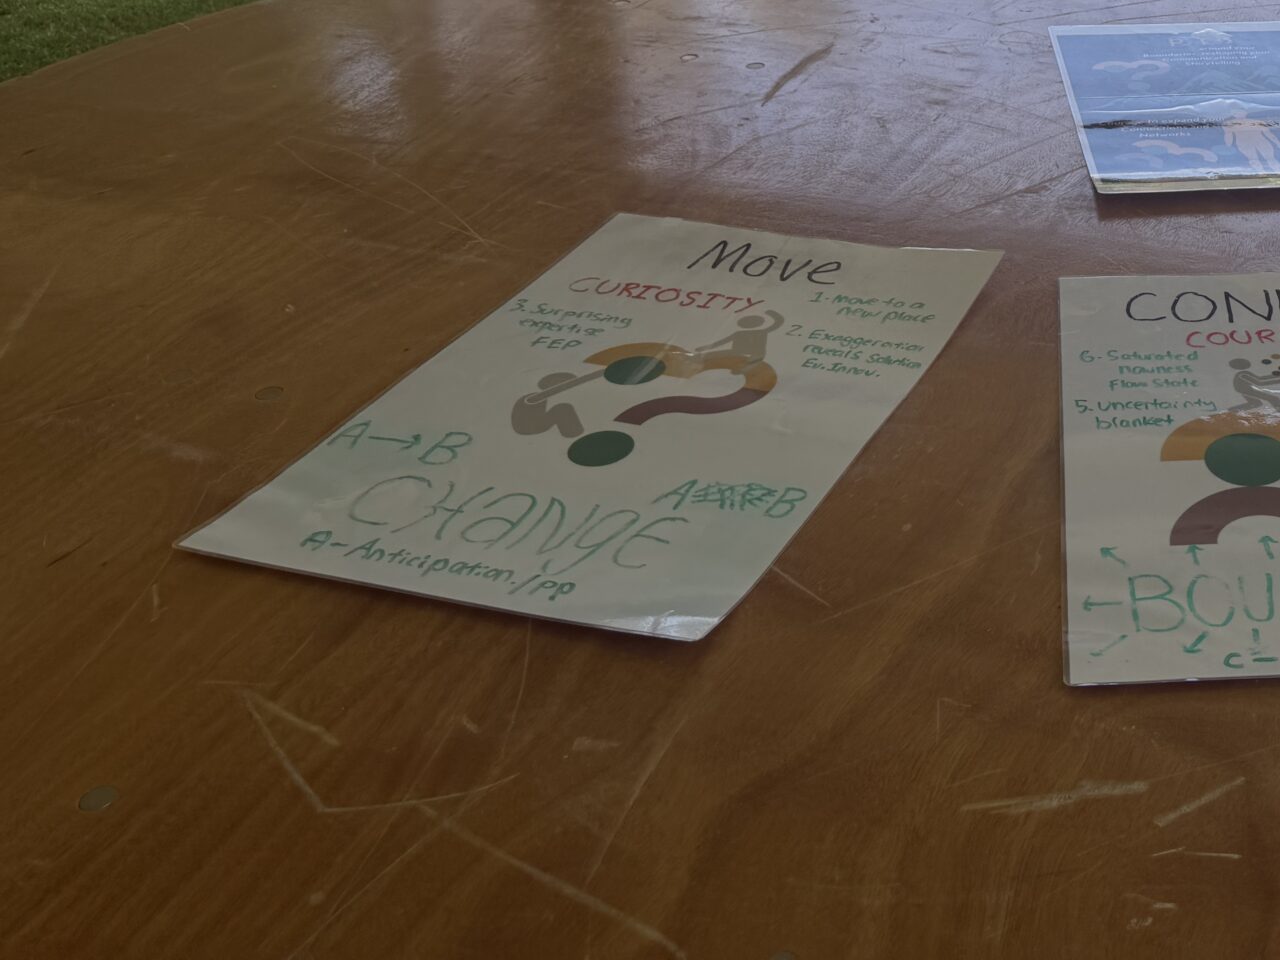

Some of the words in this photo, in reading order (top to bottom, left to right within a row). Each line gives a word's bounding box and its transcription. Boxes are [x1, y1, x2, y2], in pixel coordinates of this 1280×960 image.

[687, 240, 842, 285] Move
[569, 276, 766, 314] CURIOSITY
[536, 302, 634, 330] Surprising
[530, 336, 583, 350] FEP
[1106, 349, 1200, 362] Saturated
[418, 430, 473, 466] B
